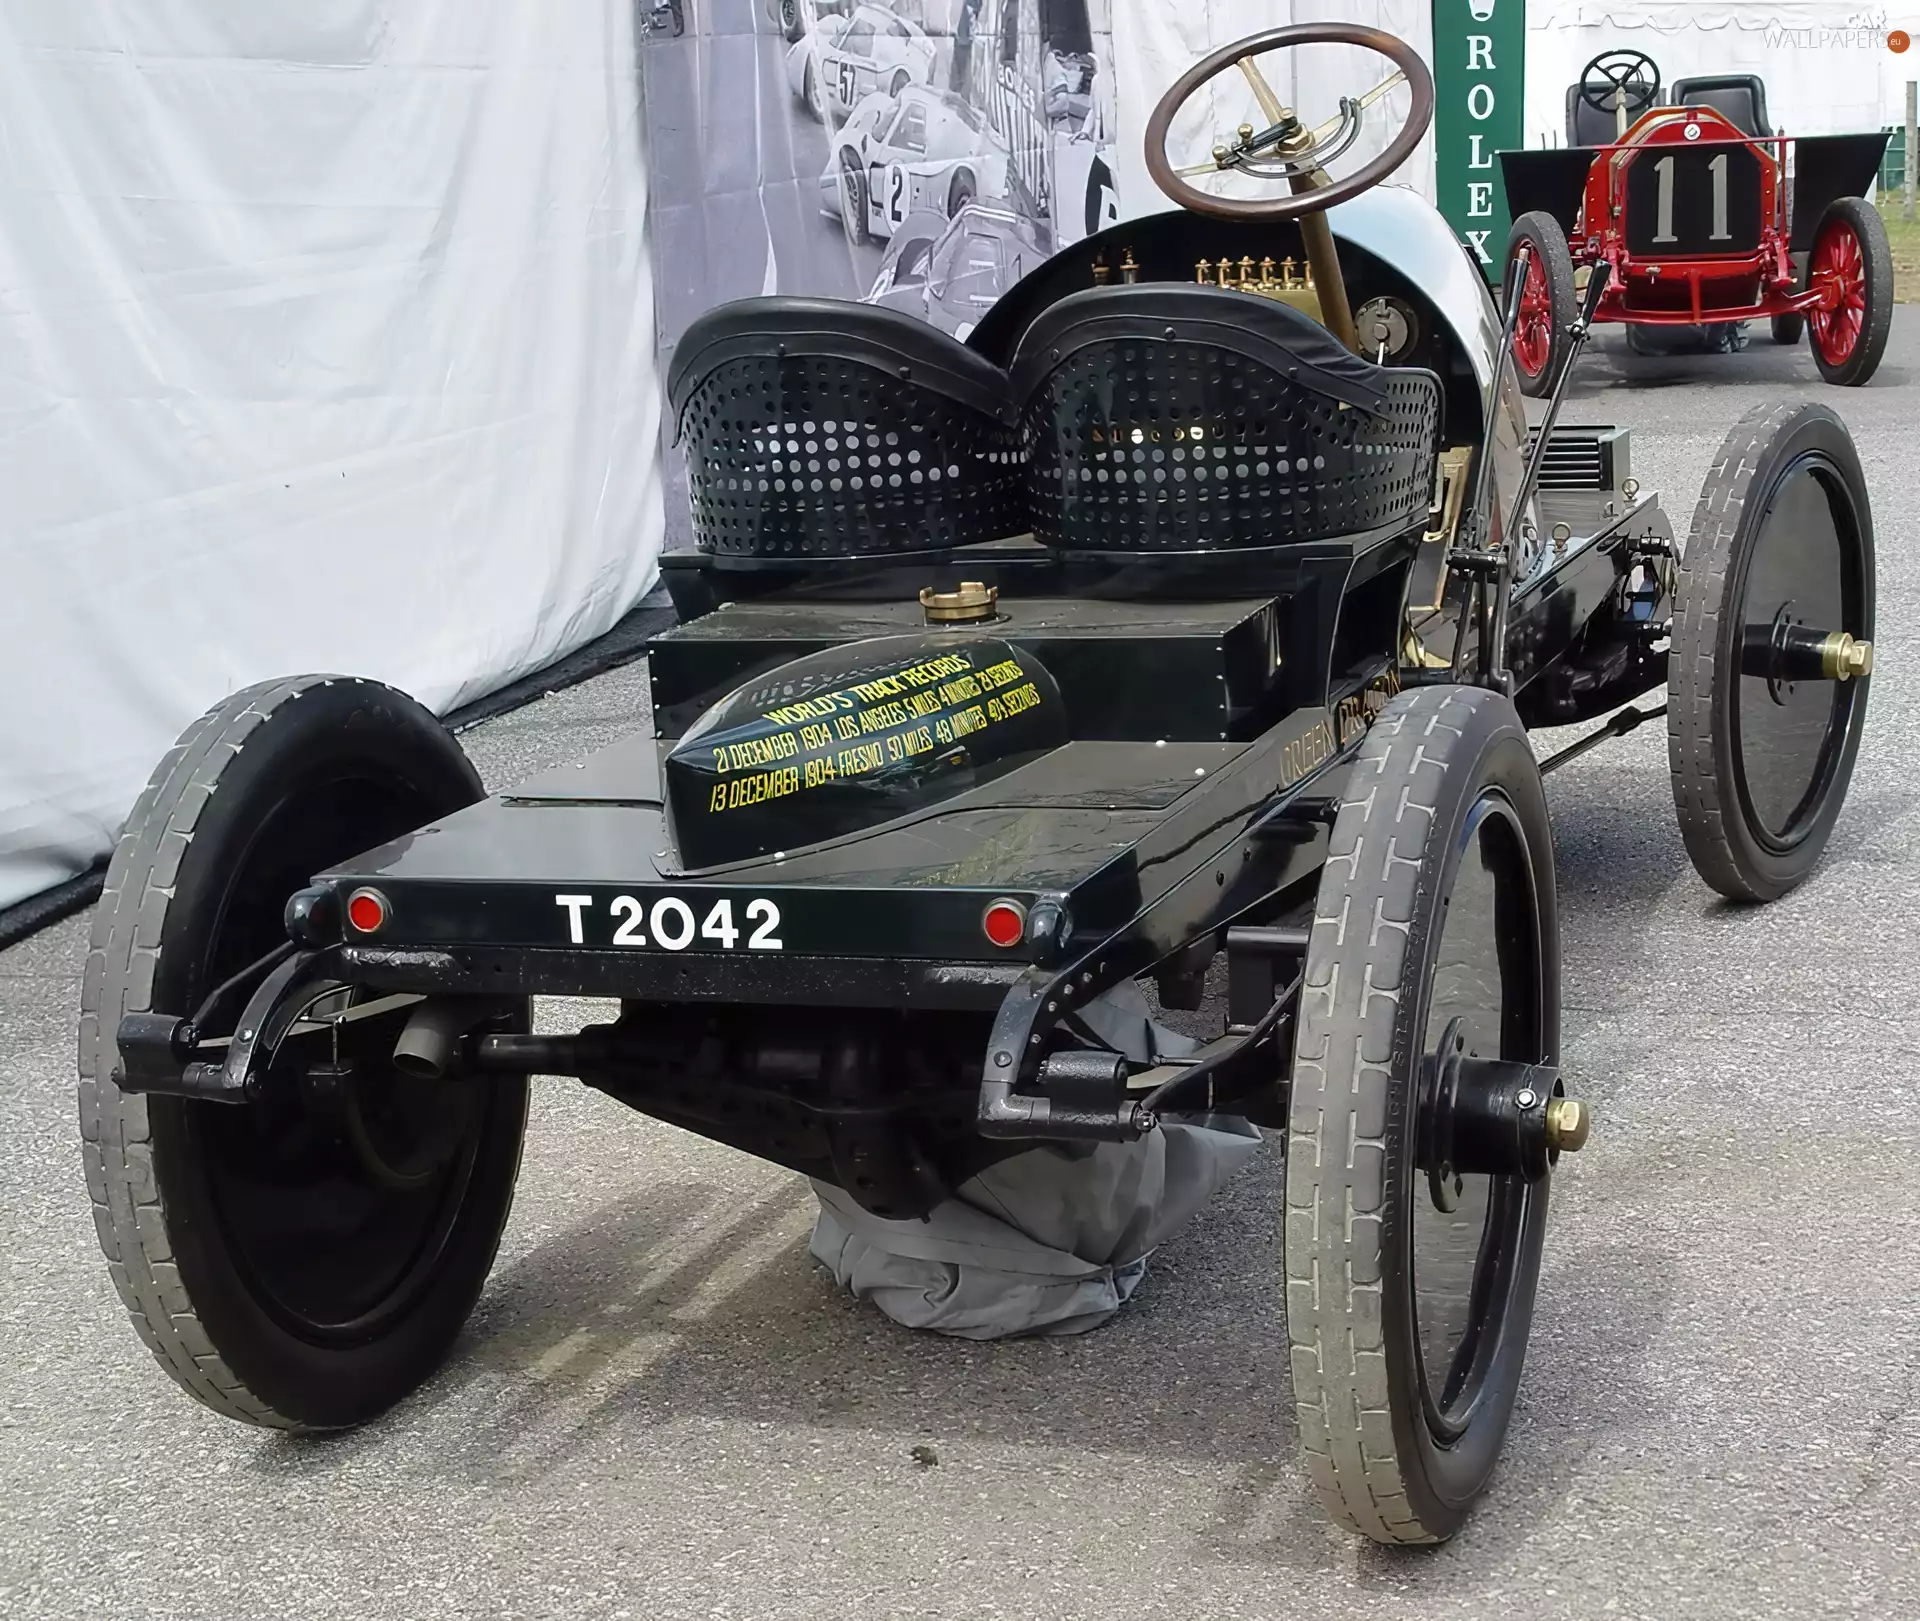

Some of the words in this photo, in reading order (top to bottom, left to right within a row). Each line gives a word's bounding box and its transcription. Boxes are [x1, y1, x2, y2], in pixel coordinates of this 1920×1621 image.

[839, 62, 856, 105] 57
[1466, 35, 1496, 264] ROLEX
[891, 166, 902, 222] 2
[1652, 154, 1732, 242] 11
[762, 691, 854, 726] WORLD'S
[848, 675, 908, 703] TRACK
[900, 654, 971, 687] RECORDS
[710, 783, 727, 812] 13
[729, 766, 799, 809] DECEMBER
[804, 755, 836, 789] 1904
[837, 742, 884, 777] FRESNO
[887, 735, 904, 761] 50
[902, 726, 934, 757] MILES
[935, 719, 953, 744] 48
[949, 705, 987, 739] MINUTES
[713, 747, 730, 774] 21
[729, 732, 799, 769] DECEMBER
[800, 722, 833, 751] 1904
[834, 715, 861, 740] LOS
[858, 701, 907, 734] ANGELES
[903, 698, 918, 719] 5
[912, 690, 942, 717] MILES
[938, 686, 951, 706] 4
[1281, 719, 1336, 787] GREEN
[555, 894, 593, 943] T
[609, 894, 783, 950] 2042
